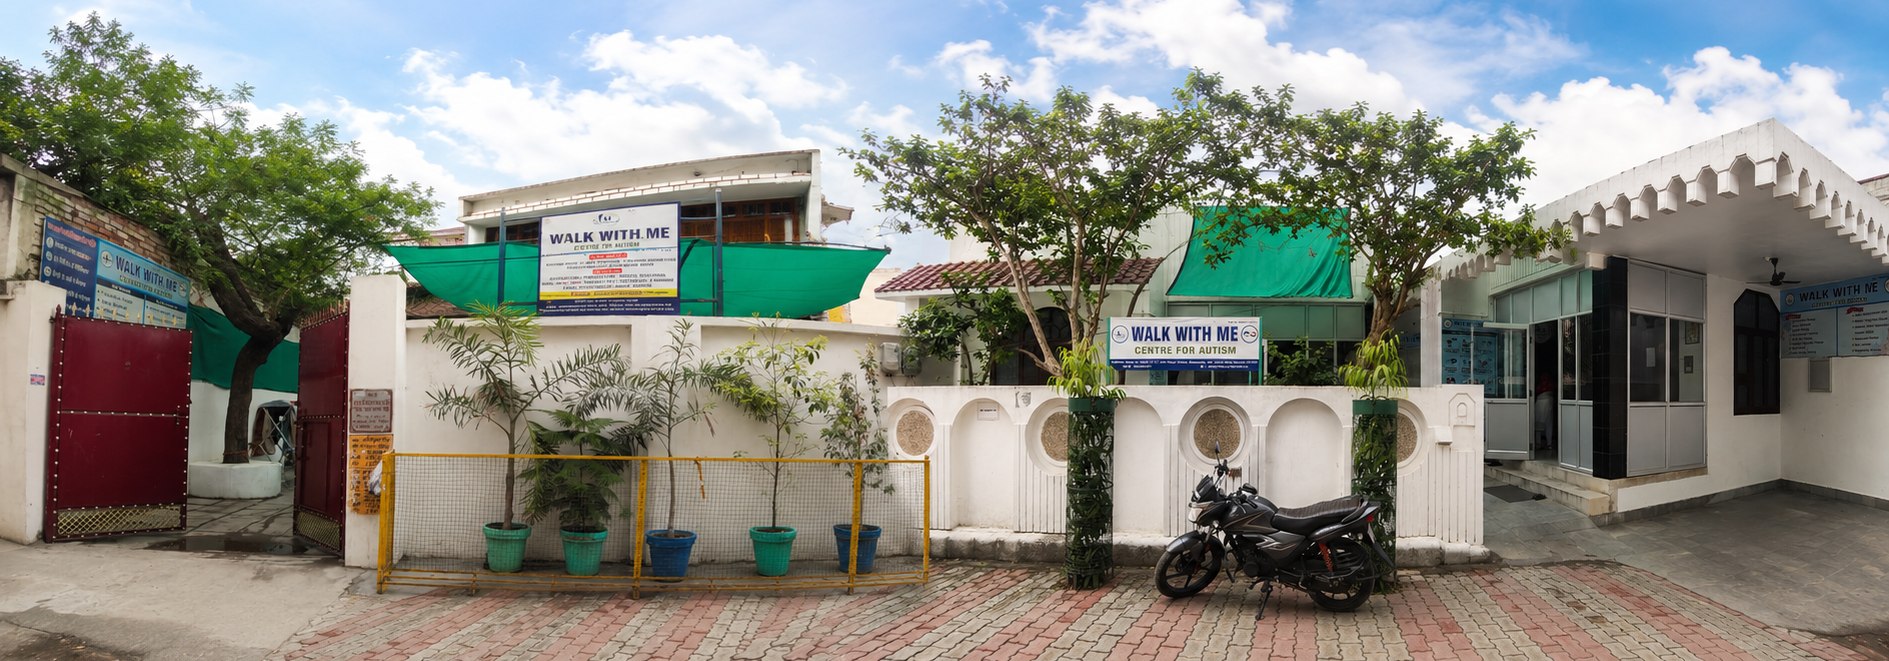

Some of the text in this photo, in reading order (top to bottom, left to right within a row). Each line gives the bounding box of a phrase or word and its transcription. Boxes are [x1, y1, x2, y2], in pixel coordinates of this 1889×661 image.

[550, 227, 670, 244] WALK WITH ME
[116, 255, 140, 278] WALK
[143, 267, 163, 286] WITH
[166, 278, 178, 293] ME
[1799, 288, 1829, 302] WALK
[1833, 284, 1860, 297] WITH
[1131, 326, 1239, 342] WALK WITH ME
[1134, 346, 1237, 355] CENTRE FOR AUTISM
